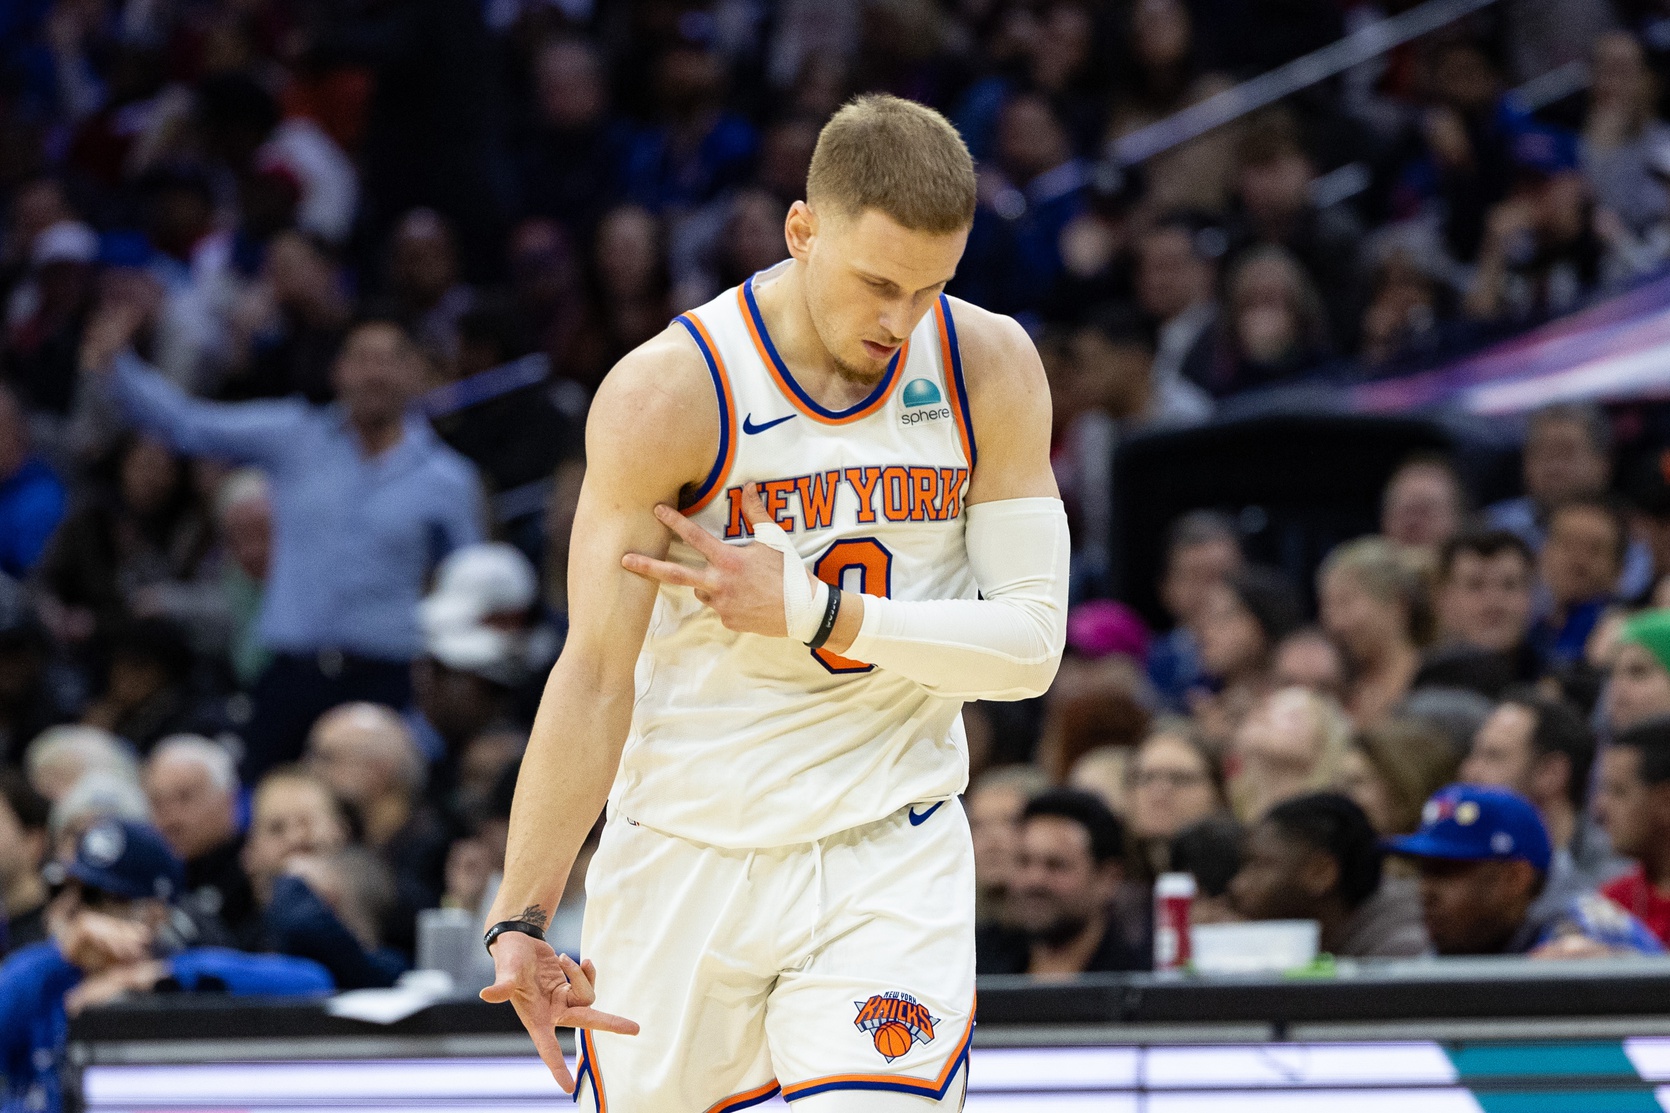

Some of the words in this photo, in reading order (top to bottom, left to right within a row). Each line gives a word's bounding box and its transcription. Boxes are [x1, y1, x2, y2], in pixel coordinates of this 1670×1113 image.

[901, 408, 949, 426] sphere
[724, 470, 840, 541] NEW
[844, 466, 968, 523] YORK
[900, 992, 917, 1005] YORK
[854, 995, 935, 1040] KNICKS
